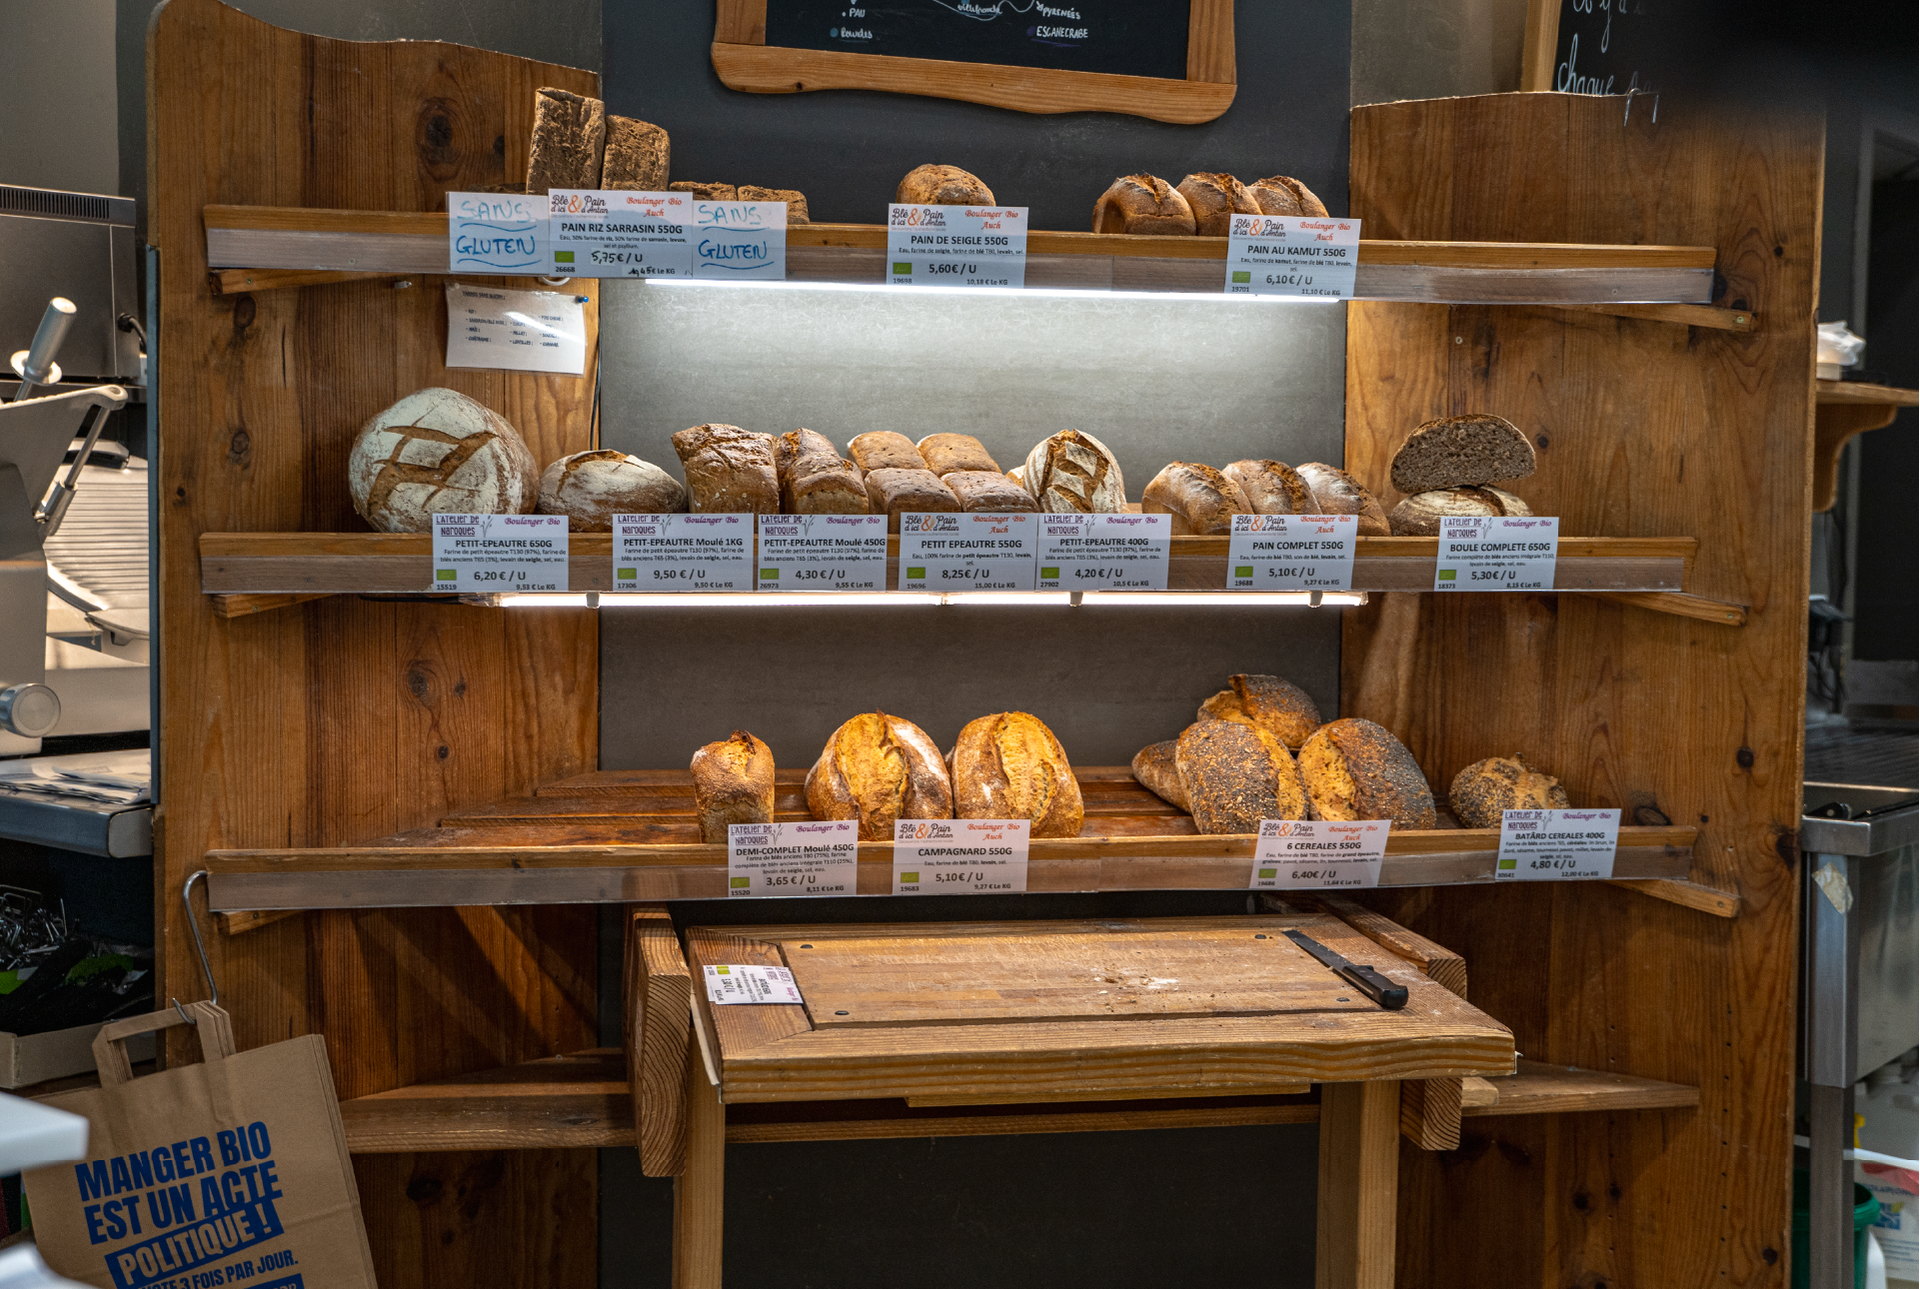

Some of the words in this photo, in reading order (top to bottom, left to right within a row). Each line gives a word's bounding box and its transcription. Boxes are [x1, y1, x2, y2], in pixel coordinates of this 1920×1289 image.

[849, 9, 865, 18] PAU
[584, 196, 606, 206] Pain
[626, 196, 665, 207] Boulanger
[457, 200, 533, 222] SANS
[698, 204, 761, 224] SANS
[562, 223, 585, 232] PAIN
[589, 224, 603, 232] RIZ
[606, 225, 655, 233] SARRASIN
[658, 225, 682, 234] 550G
[455, 235, 535, 256] GLUTEN
[911, 236, 933, 244] PAIN
[937, 236, 948, 244] DE
[951, 236, 981, 245] SEIGLE
[985, 237, 1008, 245] 550G
[698, 239, 768, 260] GLUTEN
[1248, 246, 1269, 254] PAIN
[1288, 247, 1321, 256] KAMUT
[1323, 249, 1346, 257] 550G
[626, 253, 631, 263] /
[635, 254, 642, 262] U
[960, 264, 966, 275] /
[969, 265, 976, 273] U
[1297, 275, 1303, 286] /
[1305, 277, 1312, 285] U
[505, 517, 544, 527] Boulanger
[696, 538, 723, 546] Moulé
[922, 540, 946, 548] PETIT
[949, 540, 995, 548] EPEAUTRE
[998, 540, 1022, 548] 550G
[1253, 542, 1274, 550] PAIN
[1277, 542, 1319, 550] COMPLET
[1450, 544, 1478, 552] BOULE
[1528, 543, 1550, 551] 650G
[474, 572, 497, 581] 6,20
[500, 572, 506, 580] €
[509, 571, 514, 582] /
[518, 572, 525, 580] U
[654, 570, 676, 580] 9,50
[680, 570, 686, 579] €
[689, 569, 694, 580] /
[698, 570, 705, 578] U
[795, 570, 818, 580] 4,30
[820, 570, 826, 579] €
[829, 569, 834, 580] /
[837, 570, 845, 579] U
[973, 569, 979, 579] /
[982, 570, 989, 578] U
[1075, 569, 1096, 579] 4,20
[1099, 569, 1105, 577] €
[1107, 568, 1113, 579] /
[1115, 569, 1123, 577] U
[1299, 567, 1305, 578] /
[1307, 568, 1315, 576] U
[1500, 570, 1506, 580] /
[1509, 571, 1516, 579] U
[736, 846, 802, 856] DEMI-COMPLET
[804, 845, 831, 853] Moulé
[918, 848, 986, 856] CAMPAGNARD
[989, 847, 1012, 855] 550G
[1295, 842, 1337, 850] CEREALES
[1530, 861, 1551, 869] 4,80
[1560, 860, 1566, 869] /
[1568, 860, 1576, 868] U
[967, 872, 973, 882] /
[976, 873, 983, 881] U
[1321, 870, 1326, 879] /
[767, 877, 788, 886] 3,65
[800, 875, 805, 885] /
[75, 1136, 215, 1202] MANGER
[216, 1121, 271, 1167] BIO
[84, 1195, 142, 1245] EST
[147, 1183, 196, 1229] UN
[200, 1160, 283, 1217] ACTE
[117, 1206, 255, 1286] POLITIQUE
[255, 1202, 272, 1234] !
[179, 1277, 195, 1289] 3
[192, 1269, 225, 1289] FOIS
[225, 1261, 255, 1283] PAR
[257, 1250, 298, 1273] JOUR.
